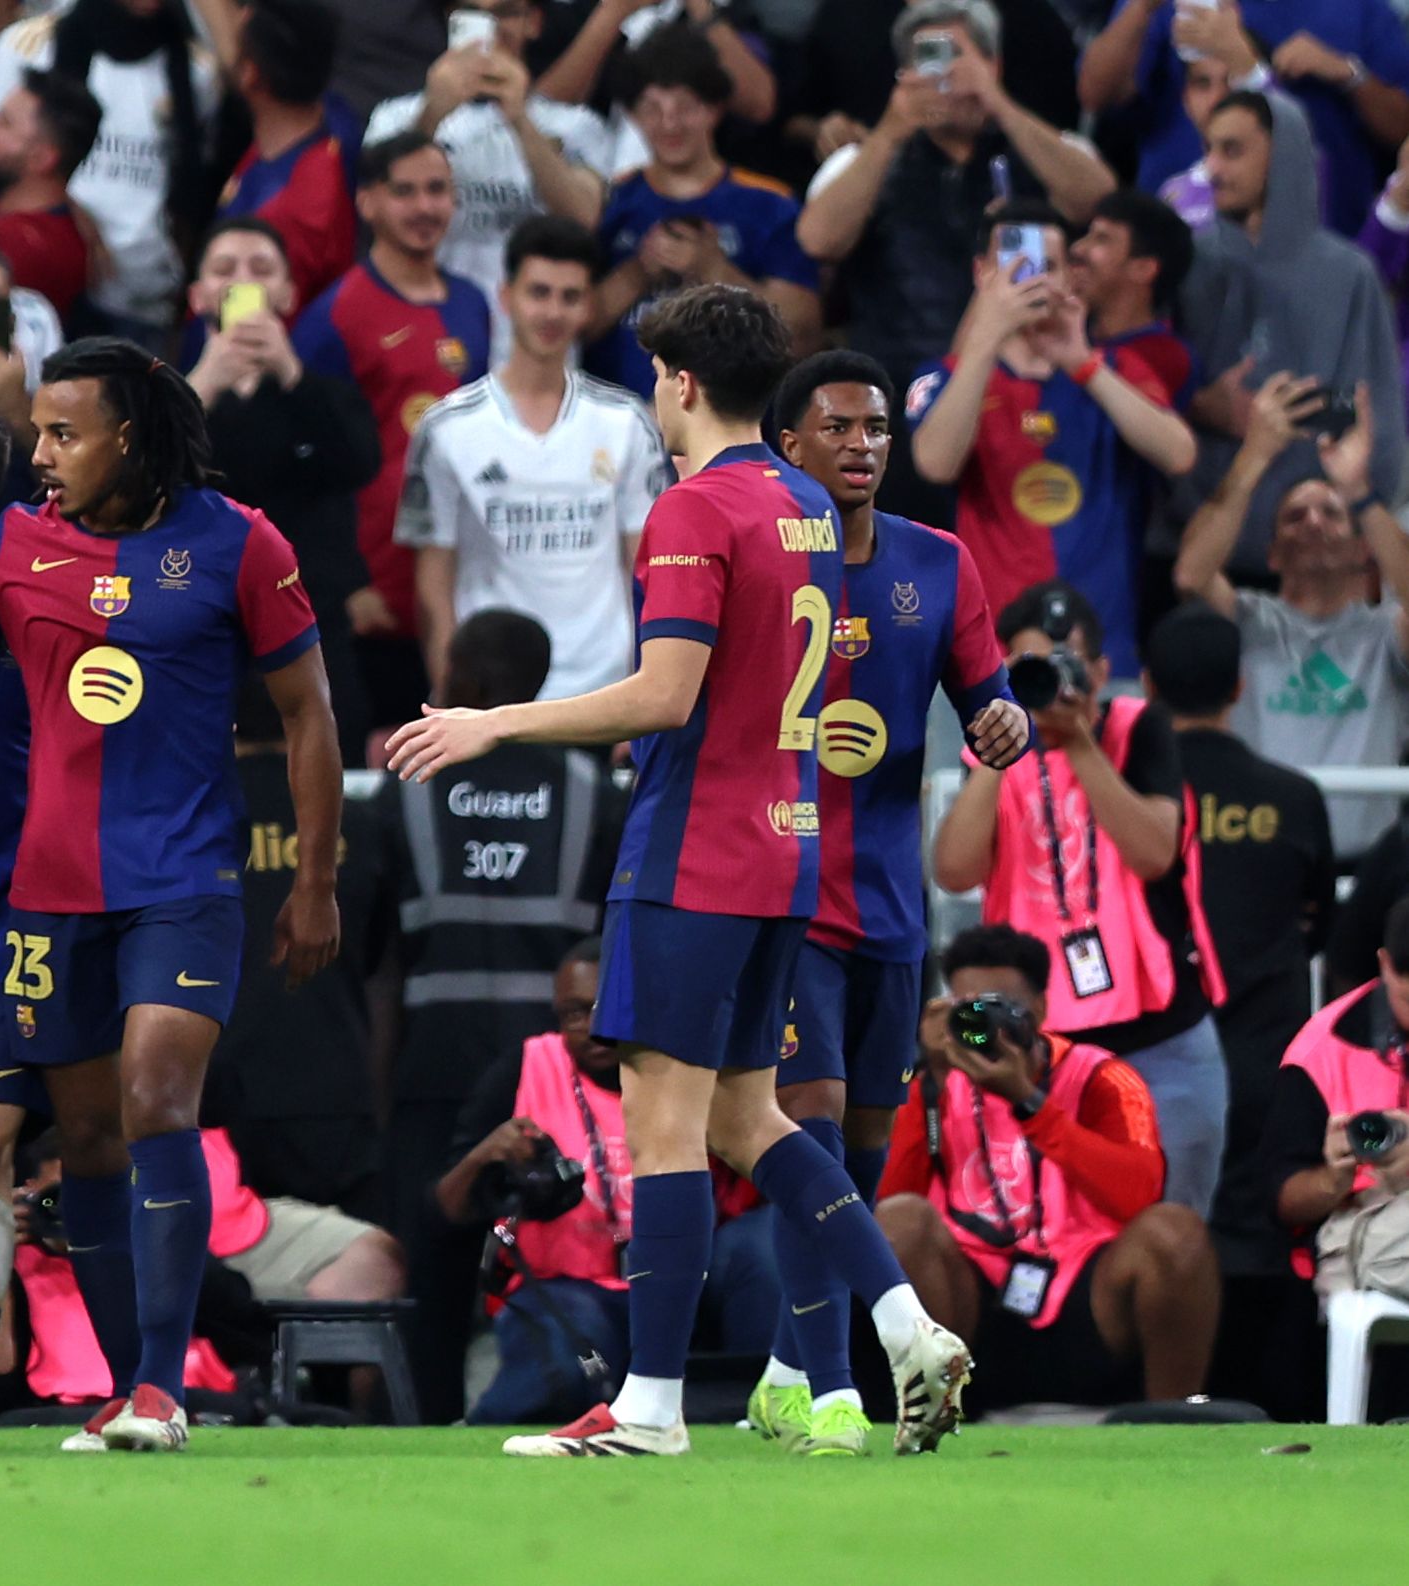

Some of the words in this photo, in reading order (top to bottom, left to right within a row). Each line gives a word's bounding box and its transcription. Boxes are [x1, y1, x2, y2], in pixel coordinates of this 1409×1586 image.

[777, 584, 831, 751] 2
[447, 781, 552, 820] Guard
[463, 840, 529, 880] 307
[4, 930, 54, 1000] 23
